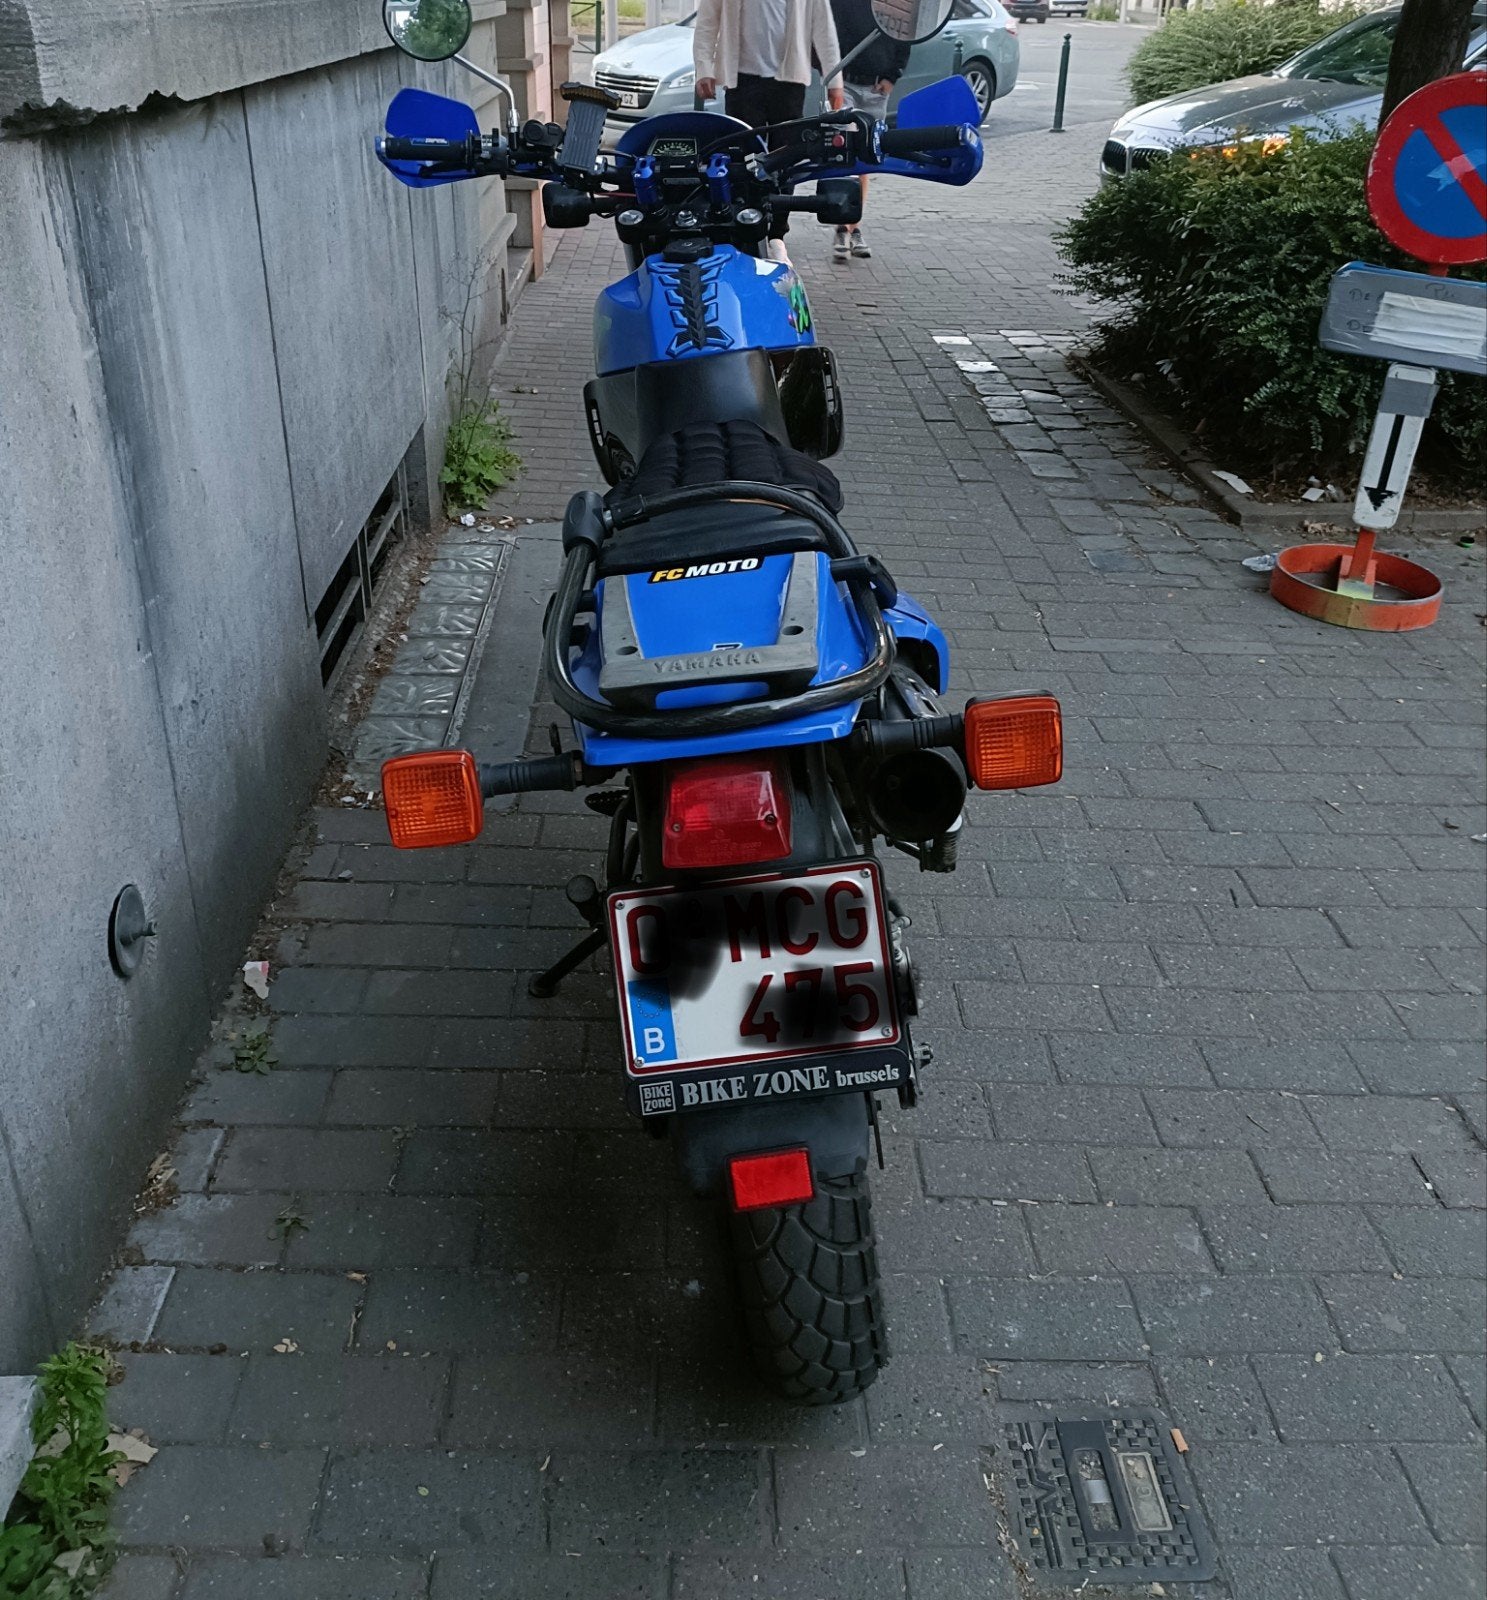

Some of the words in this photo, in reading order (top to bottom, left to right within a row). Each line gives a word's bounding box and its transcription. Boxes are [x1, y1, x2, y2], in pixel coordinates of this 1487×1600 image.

[654, 652, 760, 674] YAMAHA
[739, 961, 879, 1043] 475
[643, 1027, 666, 1054] B
[643, 1083, 672, 1099] BIKE
[680, 1076, 748, 1106] BIKE
[753, 1066, 830, 1097] ZONE
[835, 1064, 900, 1087] brussels
